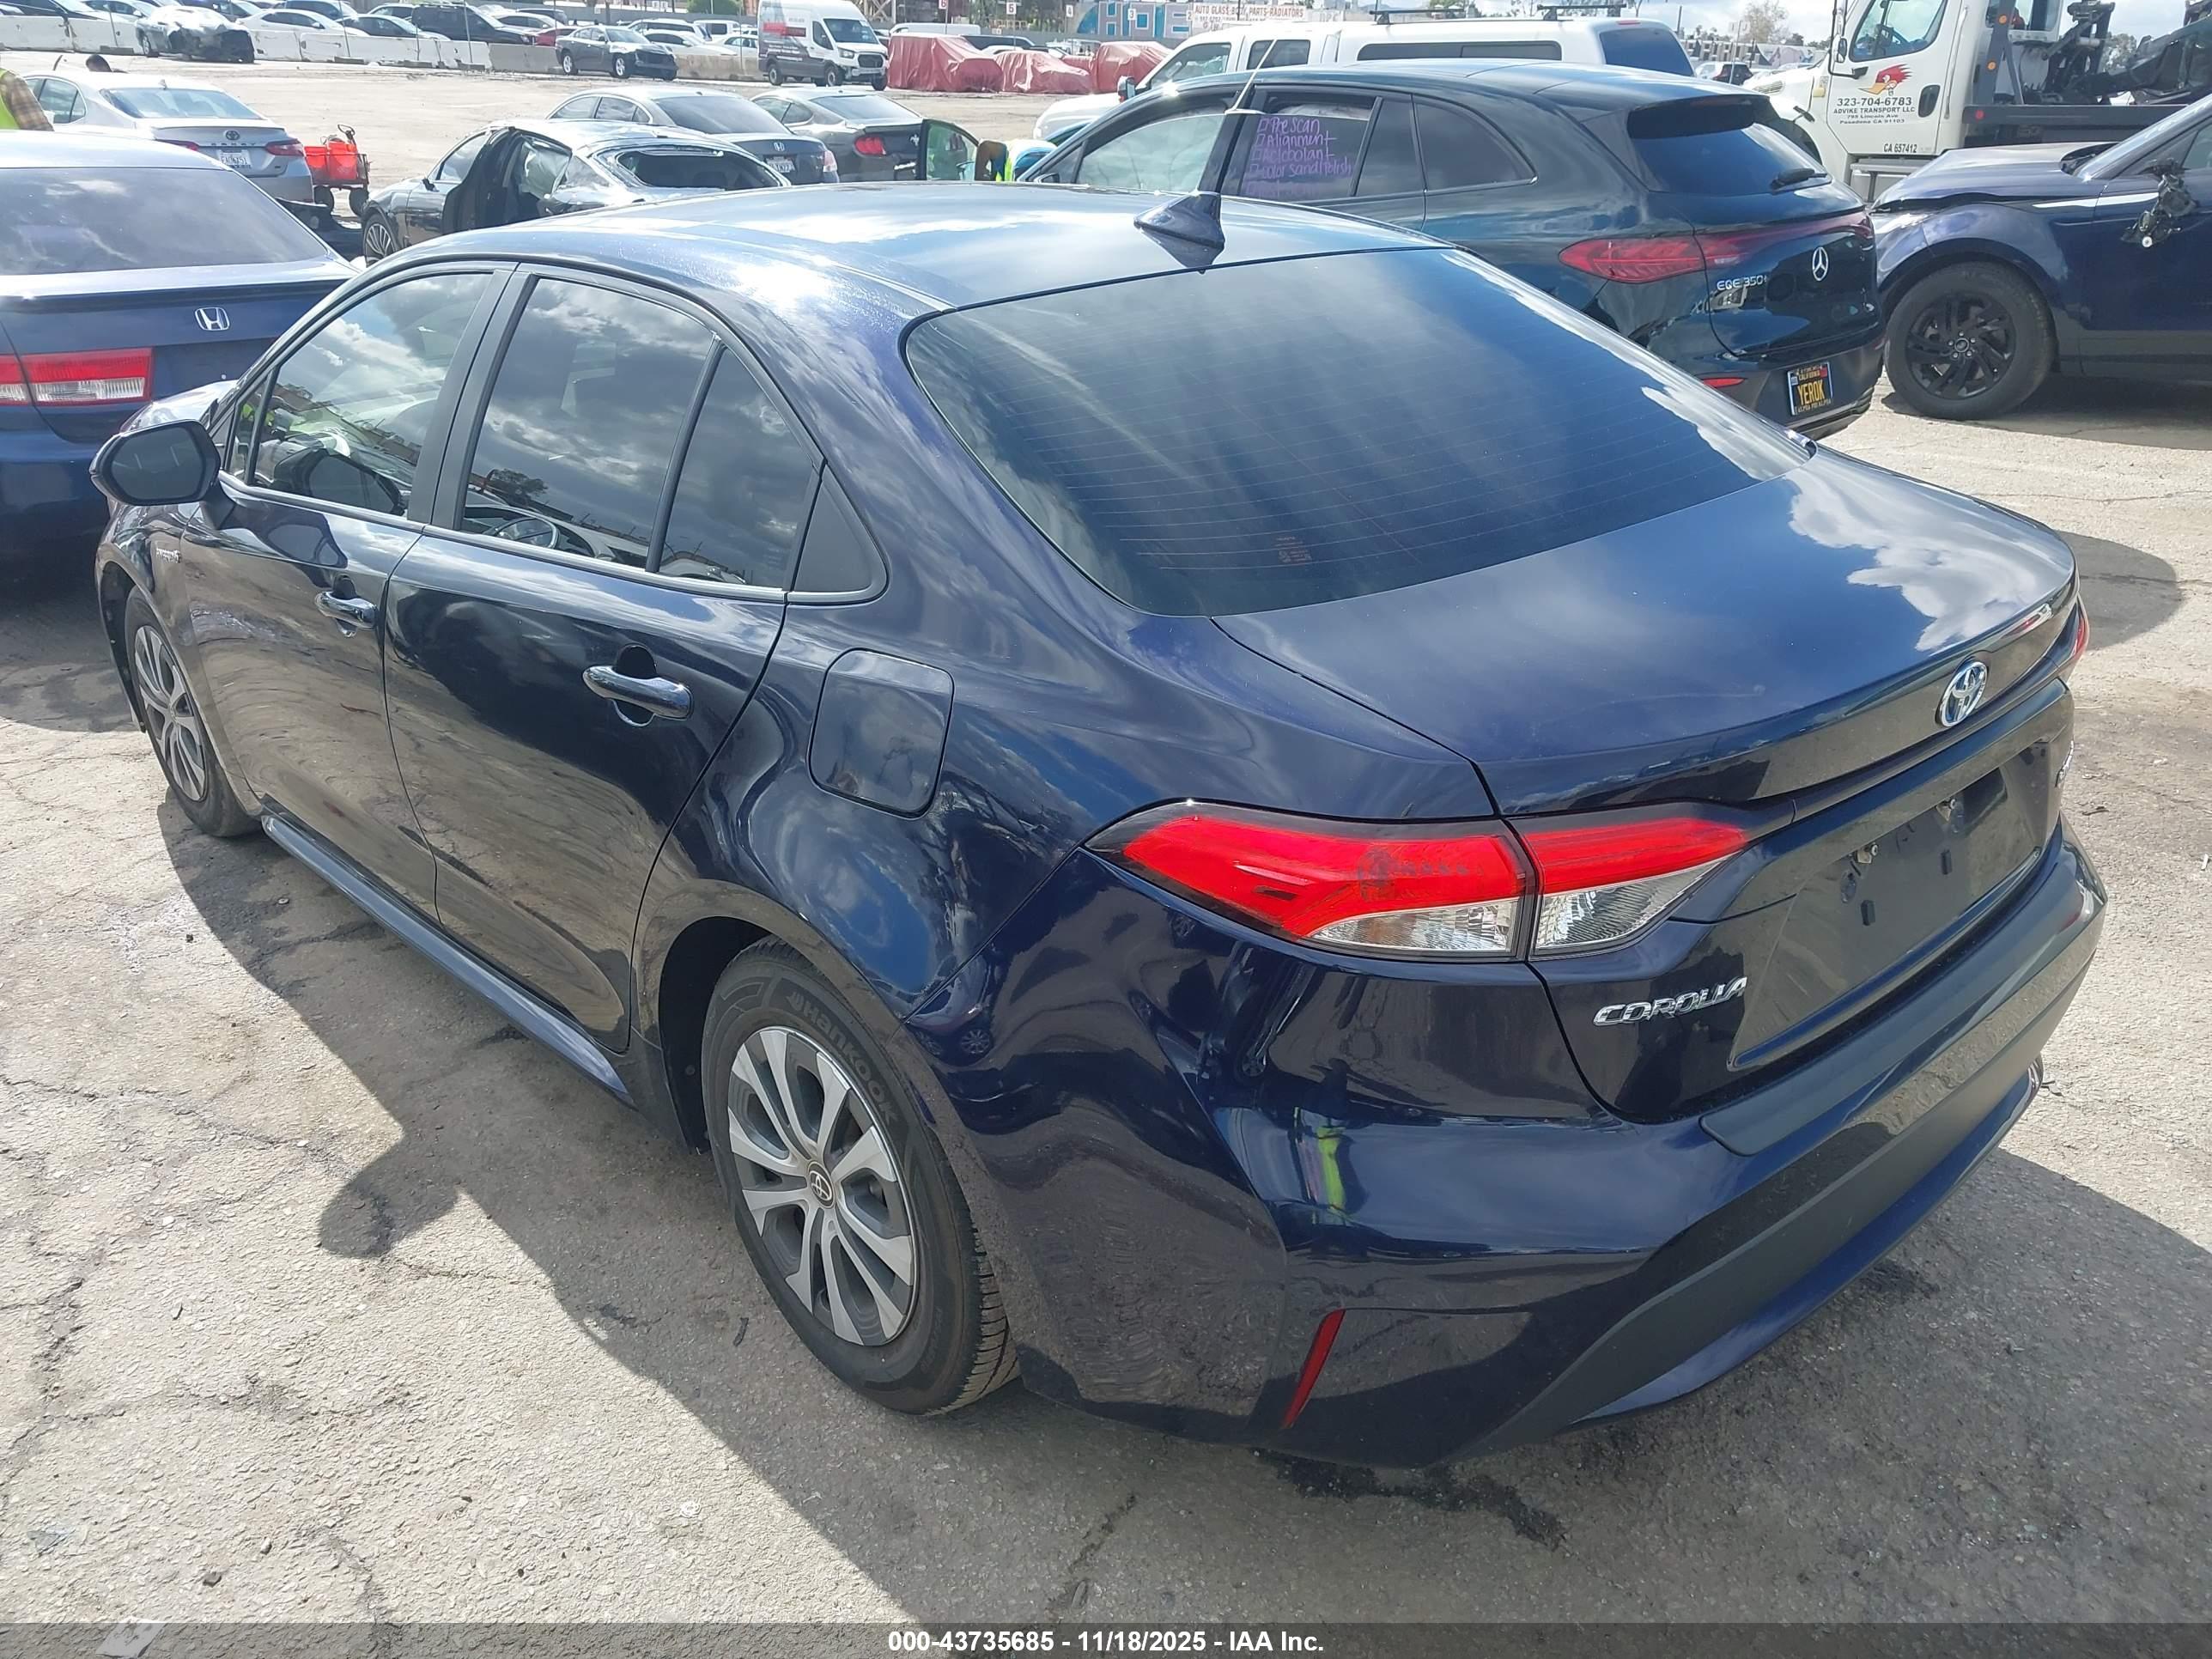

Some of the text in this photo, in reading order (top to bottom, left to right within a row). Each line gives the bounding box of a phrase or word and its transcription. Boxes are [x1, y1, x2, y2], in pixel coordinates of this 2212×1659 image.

[1008, 3, 1014, 13] 5
[1837, 97, 1912, 106] 323-704-6783
[1883, 143, 1893, 153] CA
[1893, 143, 1917, 153] 657412
[1717, 279, 1742, 290] EQE
[1797, 380, 1825, 405] YEROK
[1593, 976, 1747, 1026] COROLLA
